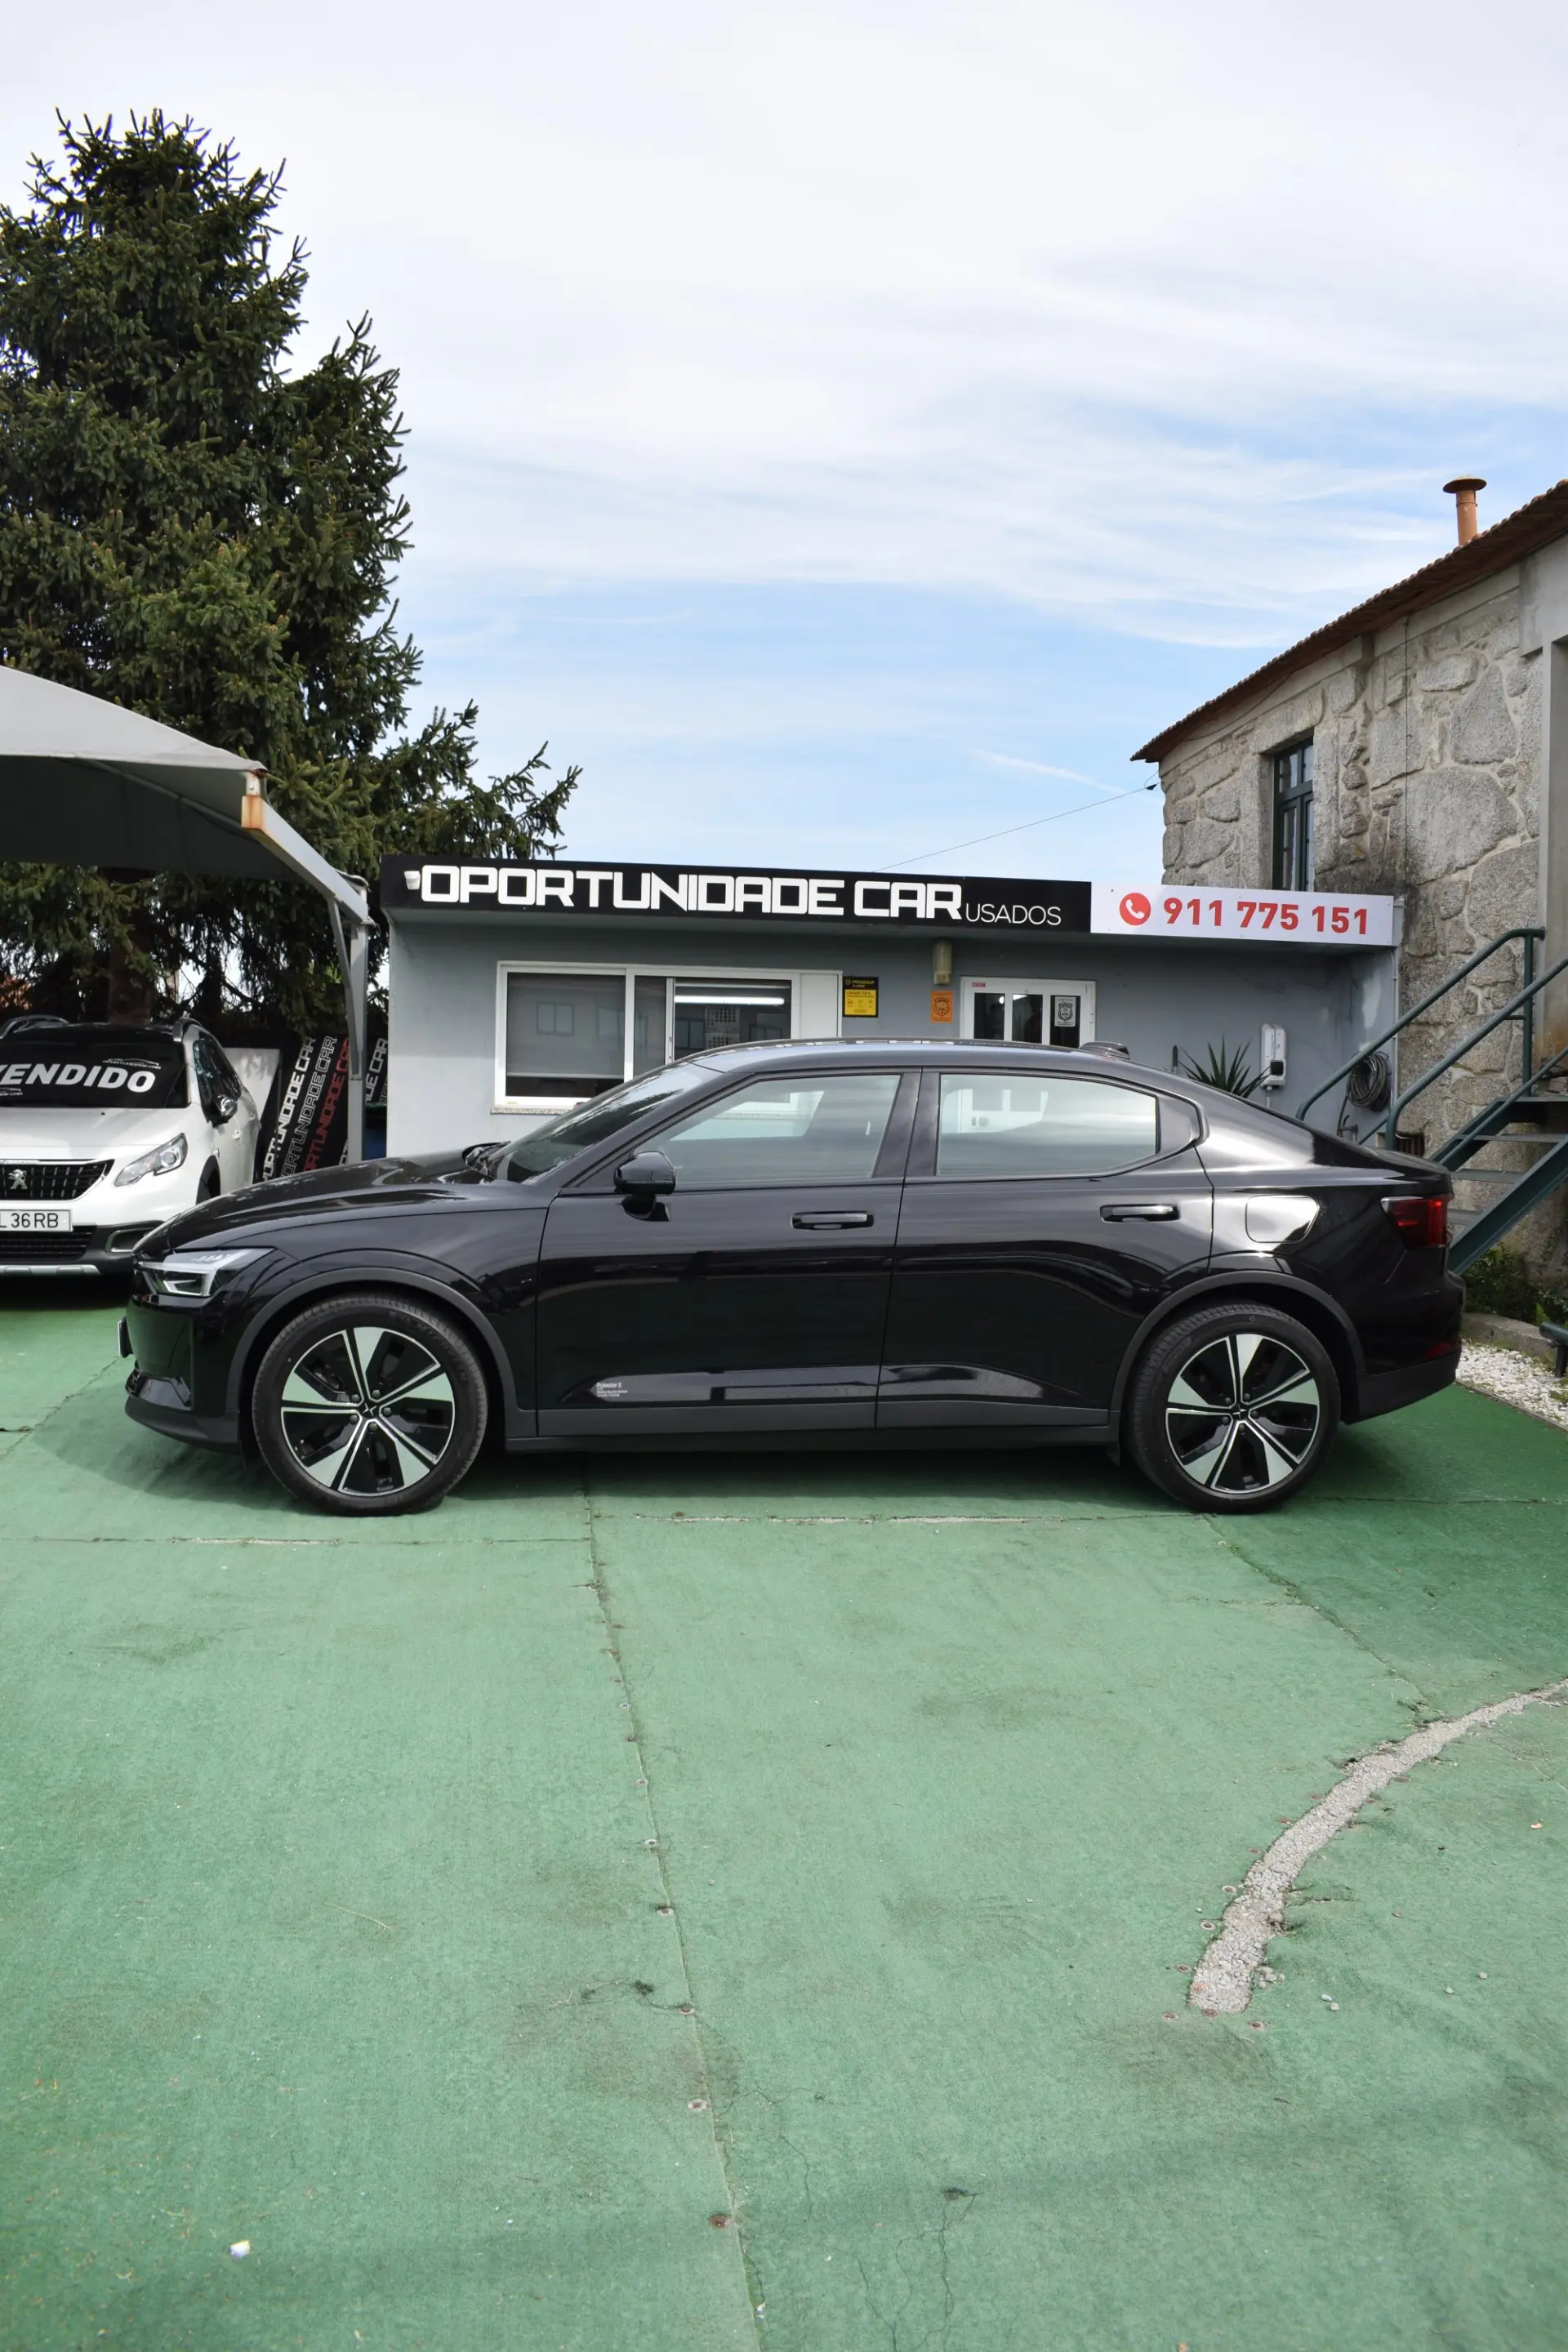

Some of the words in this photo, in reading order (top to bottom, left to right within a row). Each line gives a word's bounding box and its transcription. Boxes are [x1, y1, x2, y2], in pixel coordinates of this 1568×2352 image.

[421, 864, 844, 916] OPORTUNIDADE
[854, 880, 962, 920] CAR
[966, 902, 1062, 925] USADOS
[1164, 898, 1223, 927] 911
[1237, 901, 1298, 930] 775
[1312, 906, 1367, 935] 151
[315, 1036, 337, 1073] CAR
[369, 1037, 388, 1074] CAR
[263, 1071, 305, 1182] ORTUNIDADE
[295, 1036, 316, 1072] CAR
